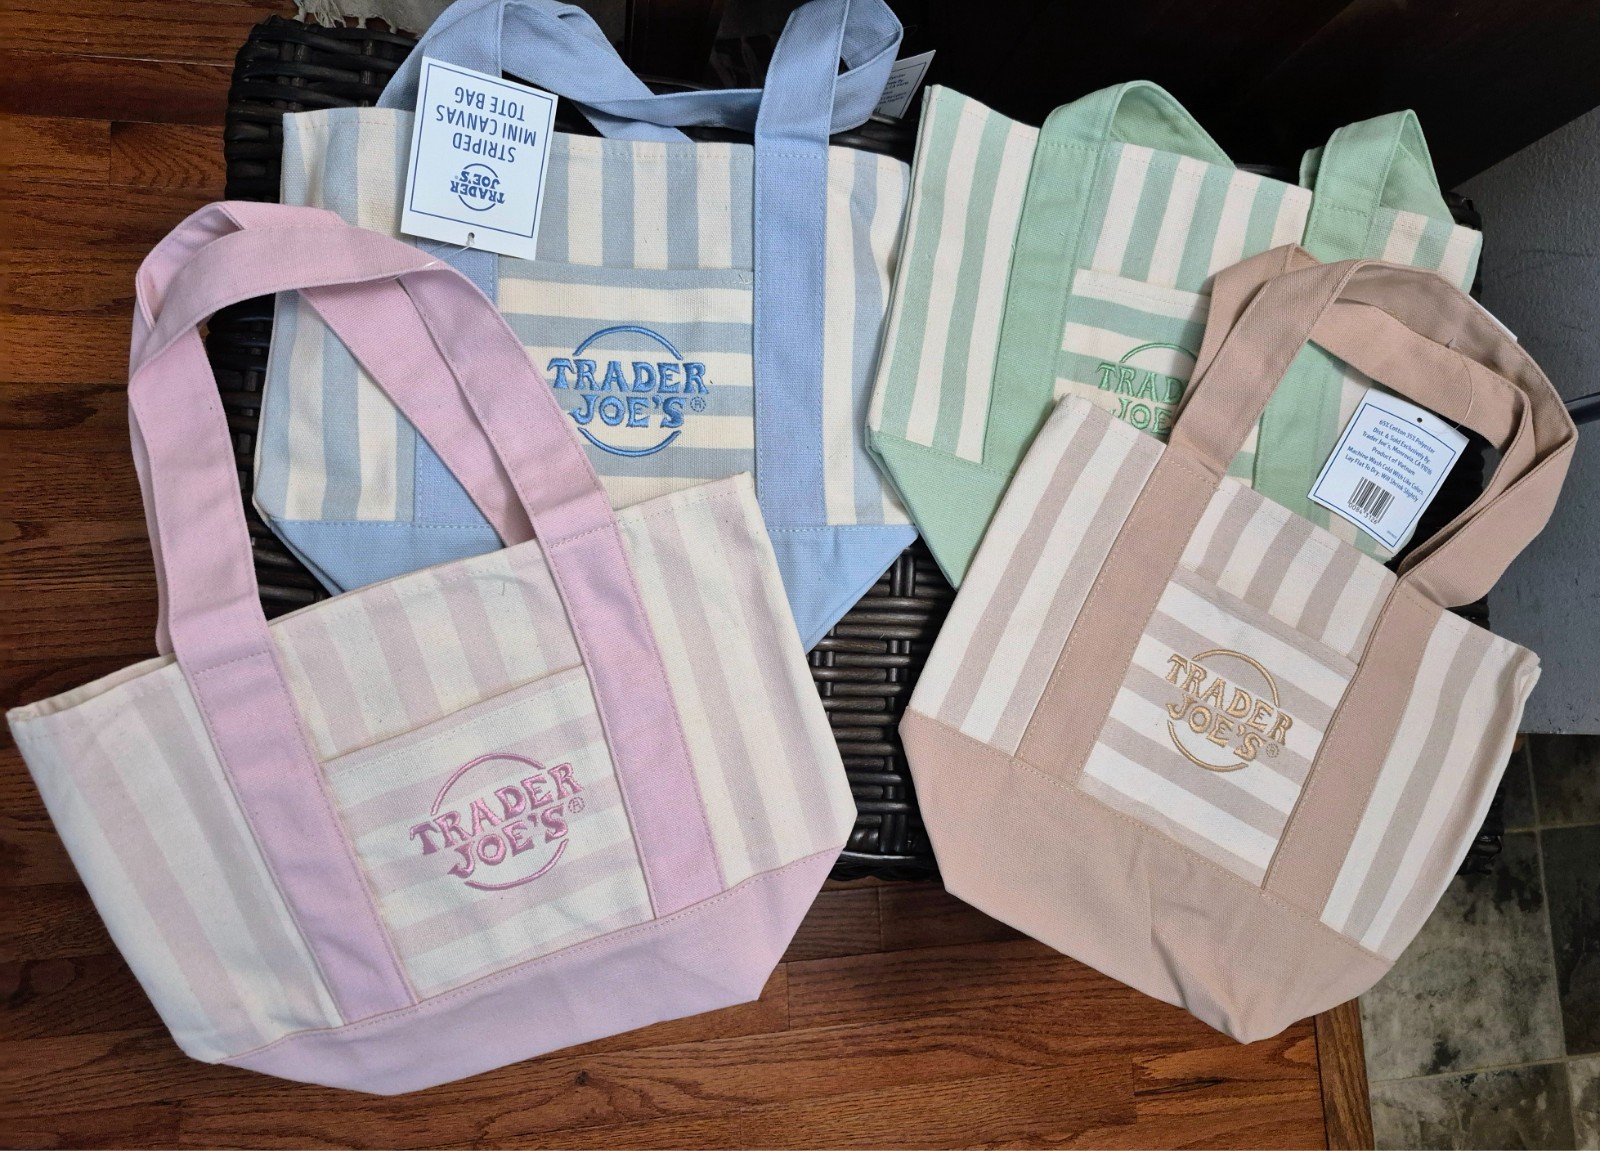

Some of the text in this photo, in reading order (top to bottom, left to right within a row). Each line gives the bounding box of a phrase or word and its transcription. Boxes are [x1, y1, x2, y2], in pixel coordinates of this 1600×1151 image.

[454, 86, 525, 122] TOTE BAG
[436, 104, 537, 147] MINI CANVAS
[452, 132, 517, 163] STRIPED
[449, 180, 505, 204] TRADER
[547, 357, 709, 395] TRADER
[1096, 362, 1186, 405] TRAD
[1110, 398, 1172, 436] JOE
[1362, 431, 1378, 442] Trader
[1390, 424, 1406, 436] Cotton
[1416, 438, 1435, 454] Polyester
[1390, 435, 1400, 444] Sold
[1400, 440, 1424, 460] Exclusively
[1345, 454, 1354, 463] Lay
[1354, 458, 1364, 468] Flat
[1380, 472, 1390, 482] Will
[1390, 480, 1404, 491] Shrink
[1402, 488, 1418, 502] Slightly
[1347, 446, 1368, 460] Machine
[1369, 456, 1382, 467] Wash
[1382, 464, 1392, 474] Cold
[1392, 469, 1404, 480] With
[1403, 476, 1412, 485] Like
[1372, 447, 1391, 460] Product
[1398, 460, 1416, 475] Vietnam
[1165, 653, 1293, 746] TRADER
[409, 762, 584, 855] TRADER
